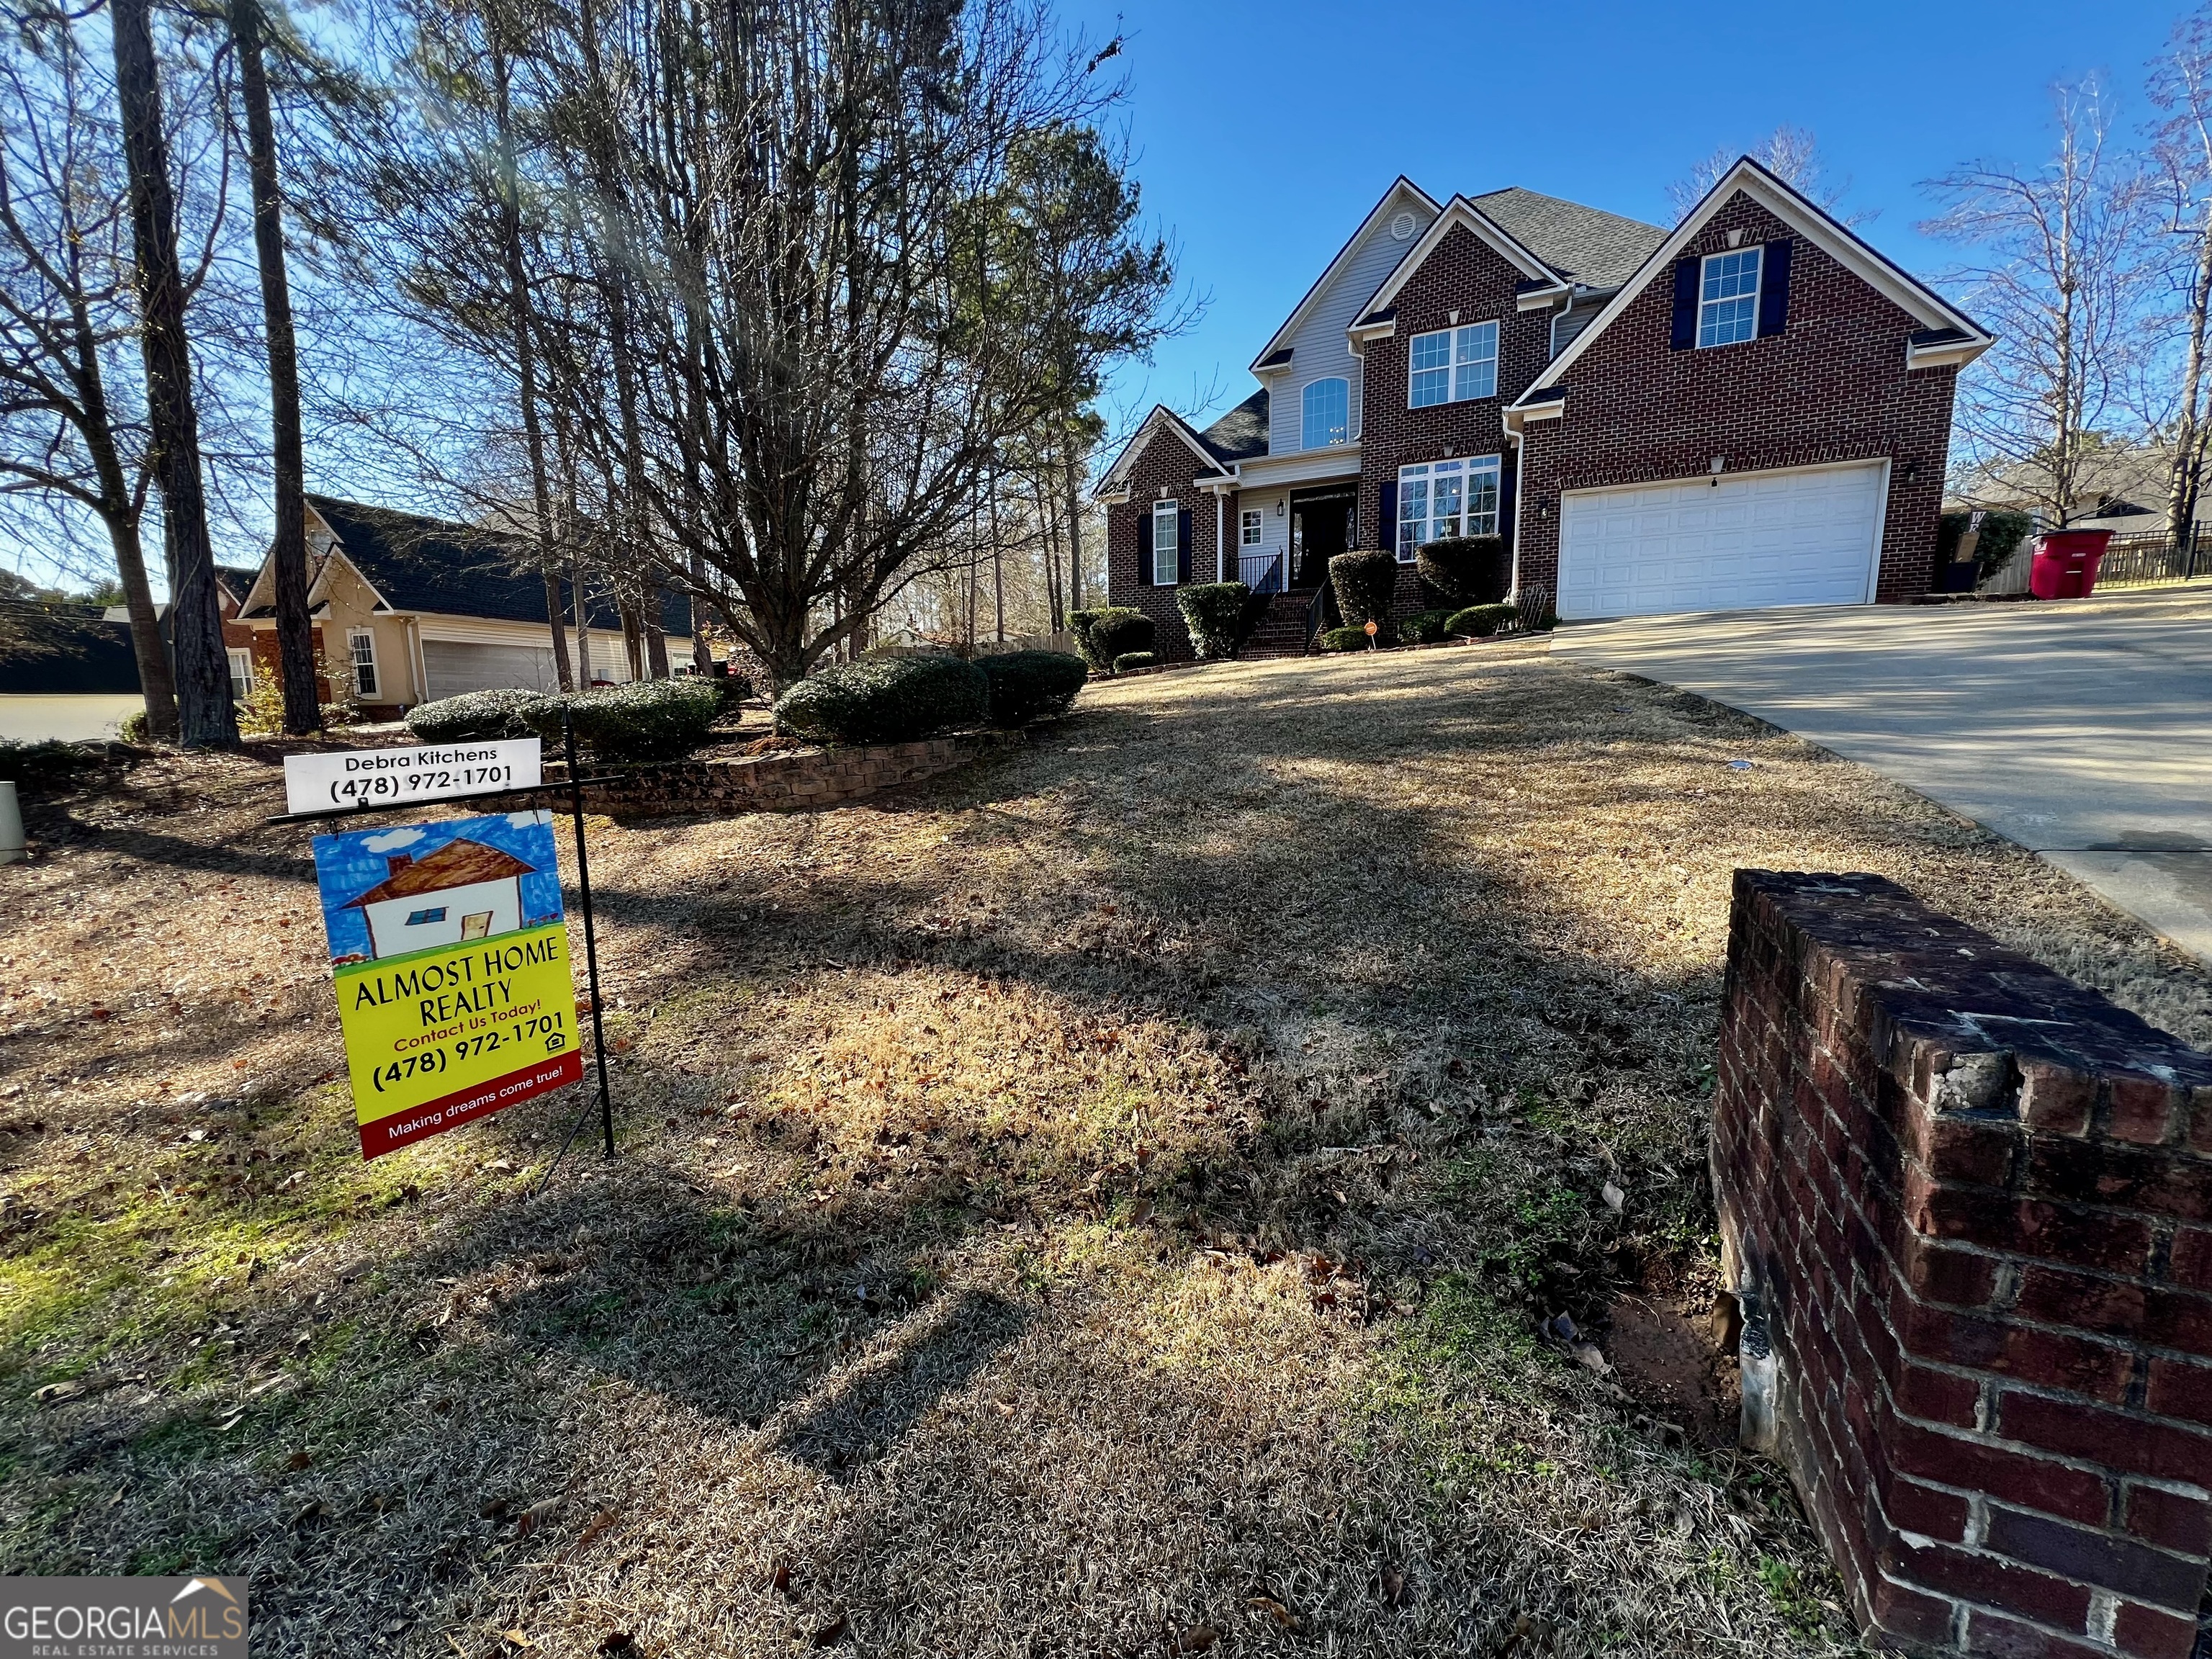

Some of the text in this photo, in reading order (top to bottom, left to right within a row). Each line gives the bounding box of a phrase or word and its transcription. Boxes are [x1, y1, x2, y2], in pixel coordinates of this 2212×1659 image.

[330, 765, 511, 803] (478) 972-1701
[346, 749, 498, 772] Debra Kitchens
[355, 937, 558, 1010] ALMOST HOME
[394, 999, 541, 1052] Contact Us Today!
[420, 978, 512, 1027] REALTY
[373, 1012, 564, 1092] (478) 972-1701
[389, 1066, 564, 1138] Making dreams come true!
